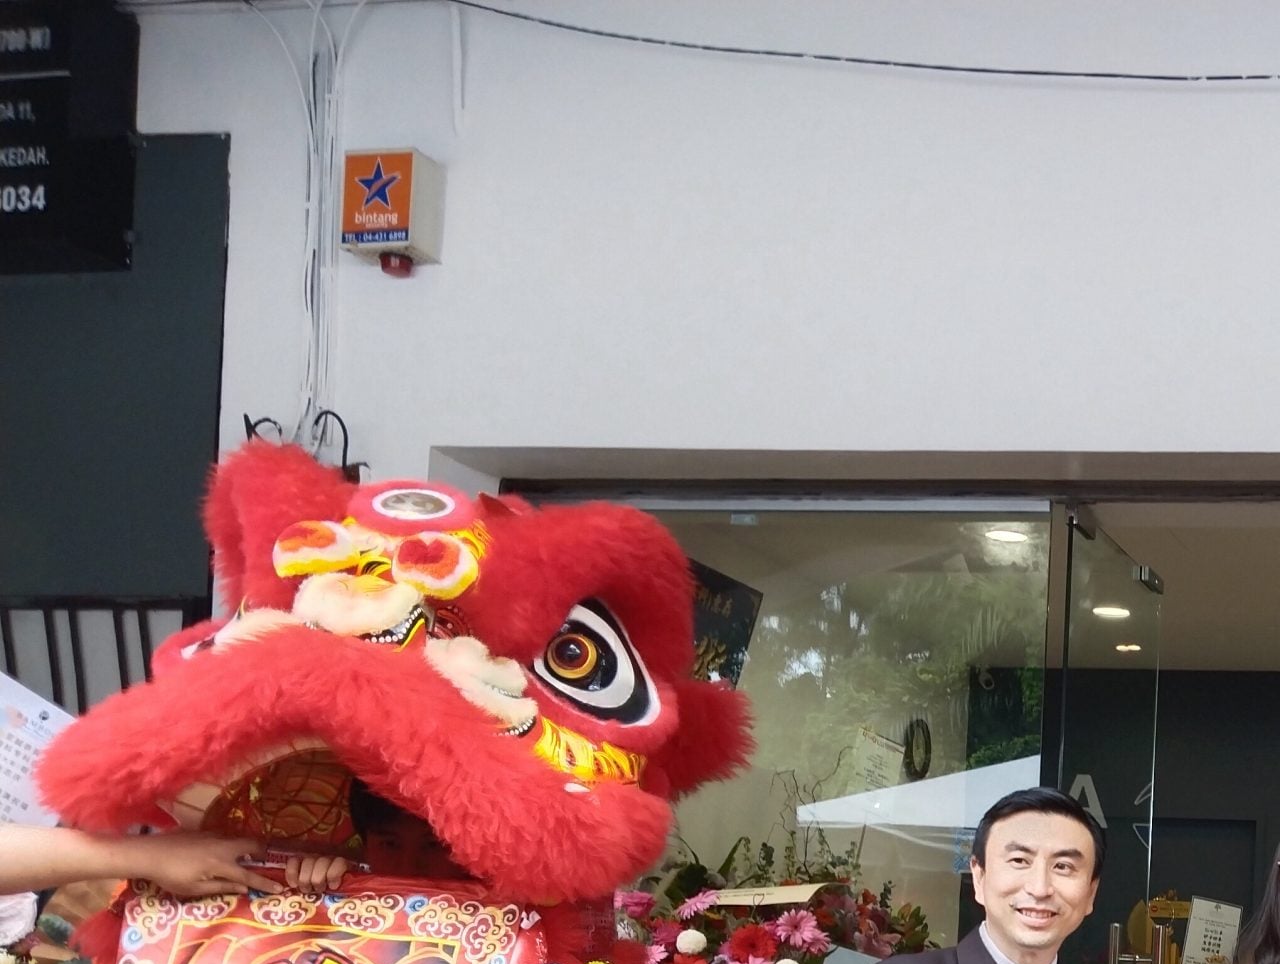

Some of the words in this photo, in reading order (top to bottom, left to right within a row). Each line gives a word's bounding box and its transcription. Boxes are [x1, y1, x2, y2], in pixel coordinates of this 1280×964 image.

[0, 184, 46, 211] 034
[355, 212, 398, 225] bintang
[345, 233, 356, 242] TEL
